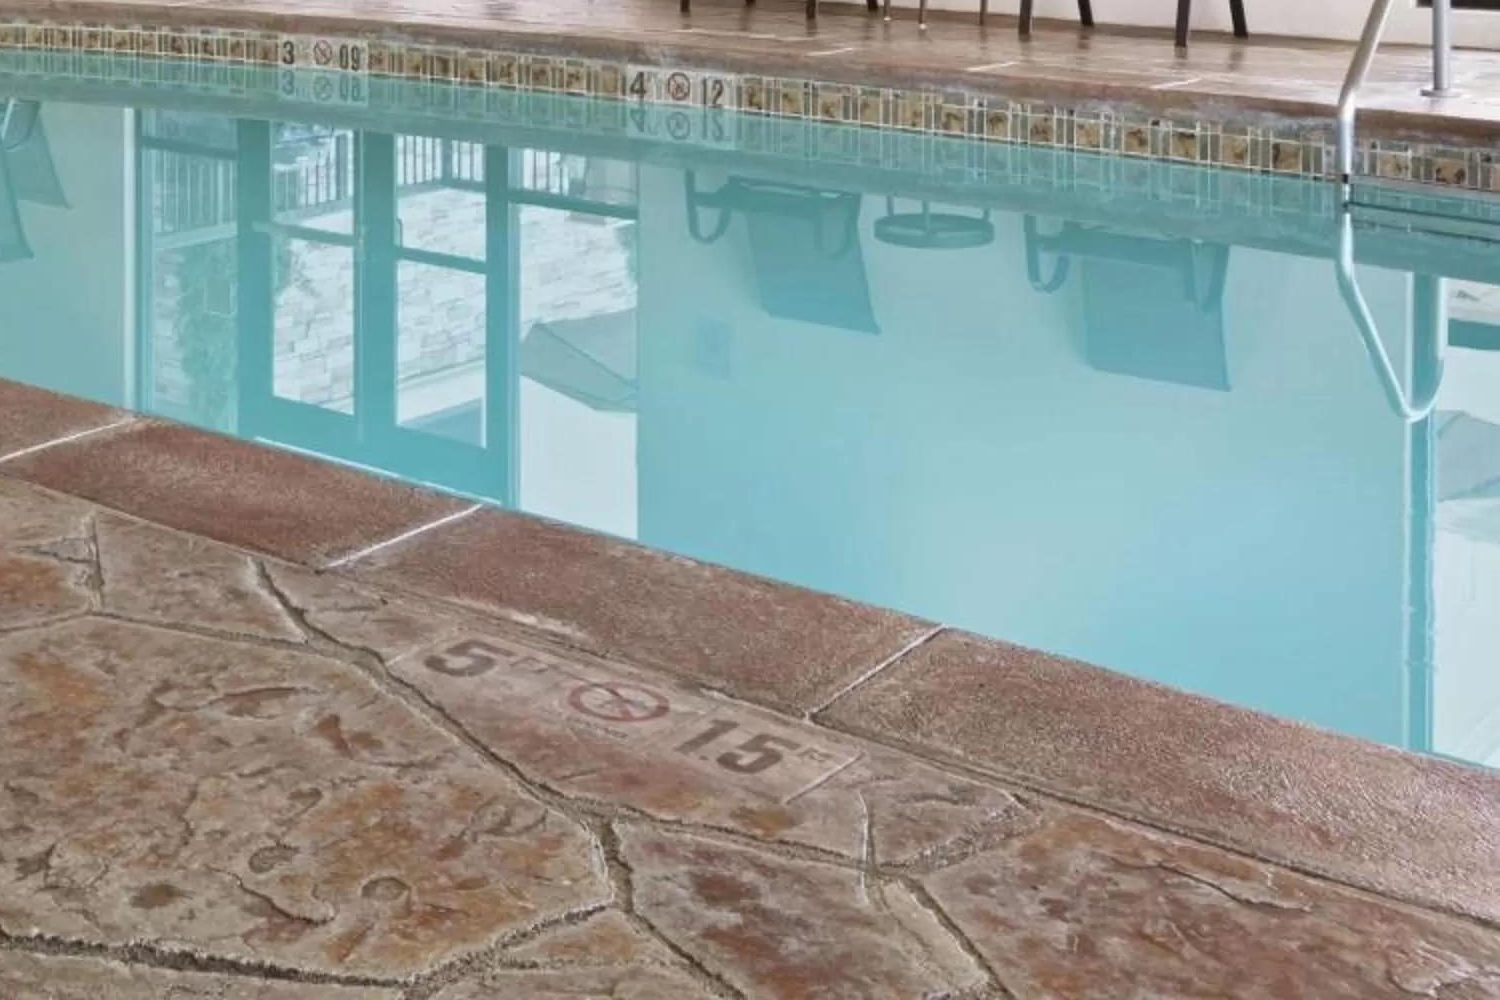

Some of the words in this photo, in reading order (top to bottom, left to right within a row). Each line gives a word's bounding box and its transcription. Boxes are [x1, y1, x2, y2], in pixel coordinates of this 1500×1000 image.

[282, 40, 295, 65] 3
[629, 71, 647, 100] 4
[423, 639, 516, 677] 5
